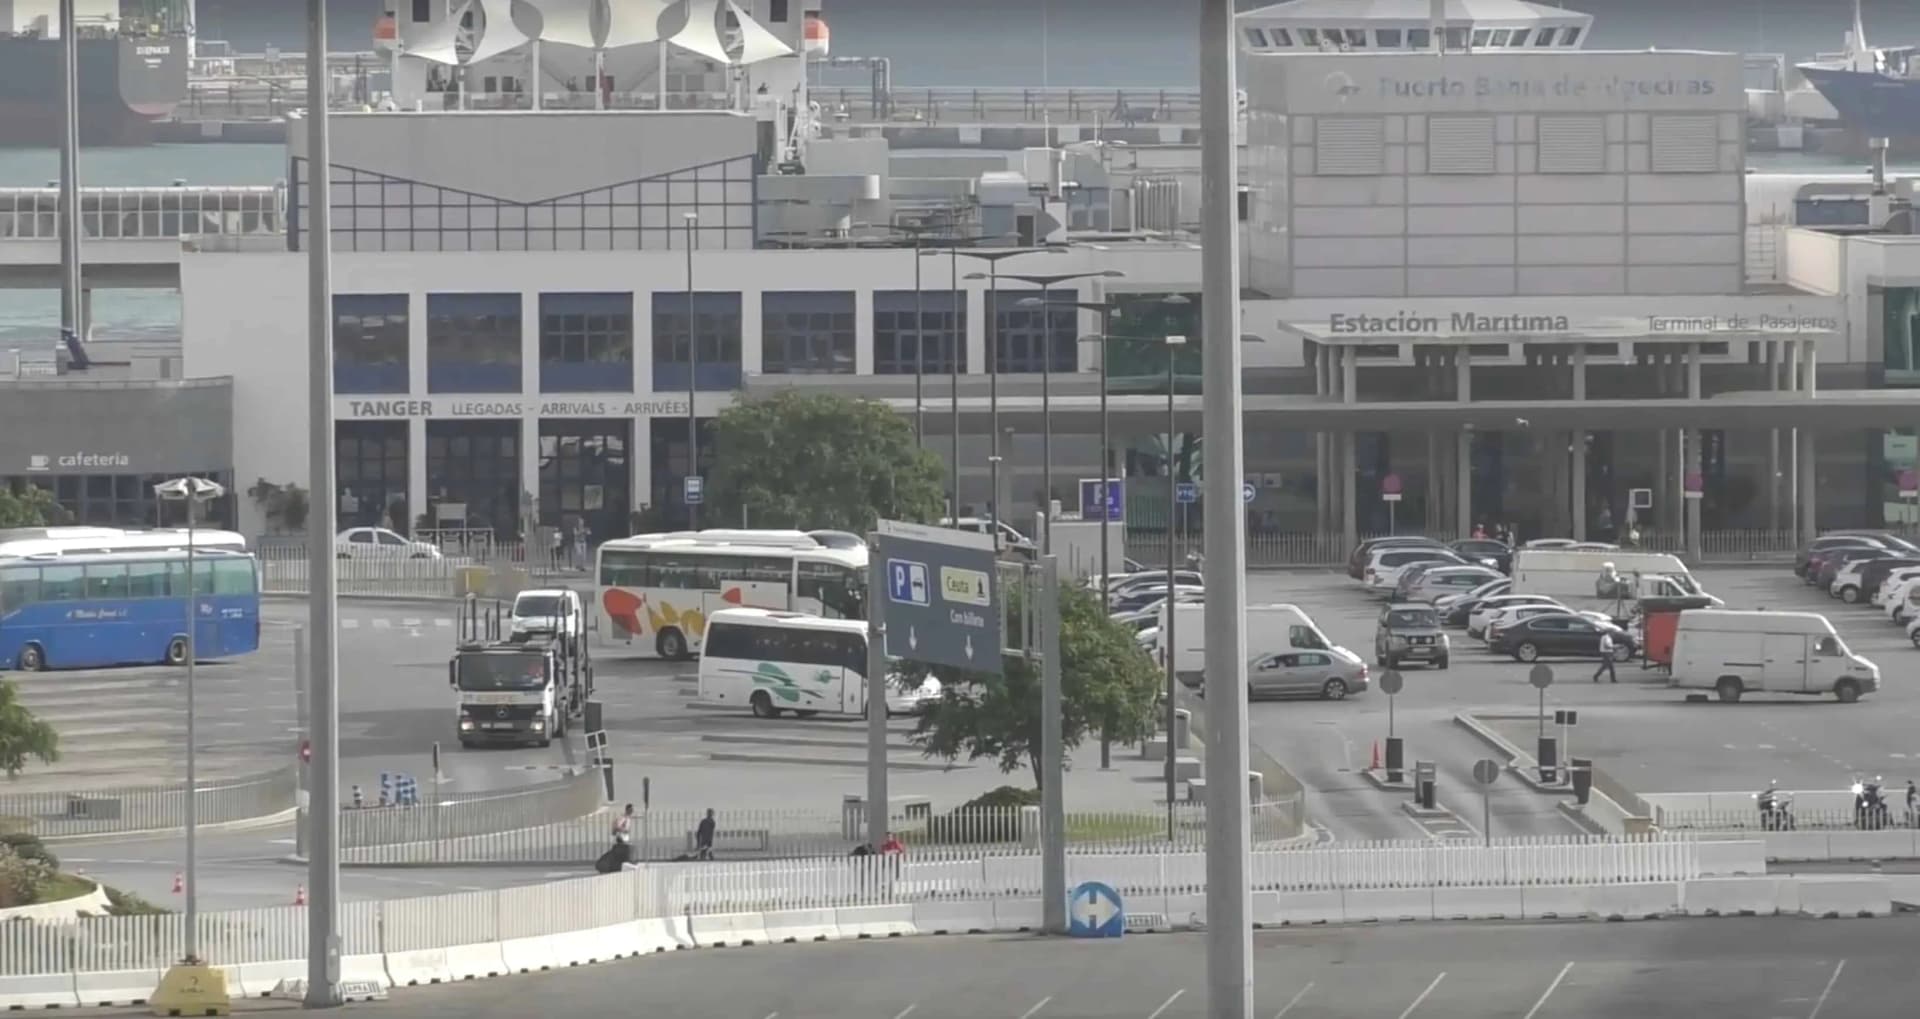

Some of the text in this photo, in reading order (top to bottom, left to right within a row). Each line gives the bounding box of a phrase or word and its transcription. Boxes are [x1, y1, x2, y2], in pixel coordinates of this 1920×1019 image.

[1330, 310, 1438, 332] Estación
[1649, 313, 1837, 334] Terminal de Pasajeros
[350, 401, 432, 416] TANGER
[452, 402, 523, 415] LLEGADAS
[540, 402, 606, 415] ARRIVALS
[624, 400, 689, 414] ARRIVÉES
[59, 451, 129, 466] cafeteria
[895, 565, 905, 597] P
[946, 575, 969, 594] Ceuta
